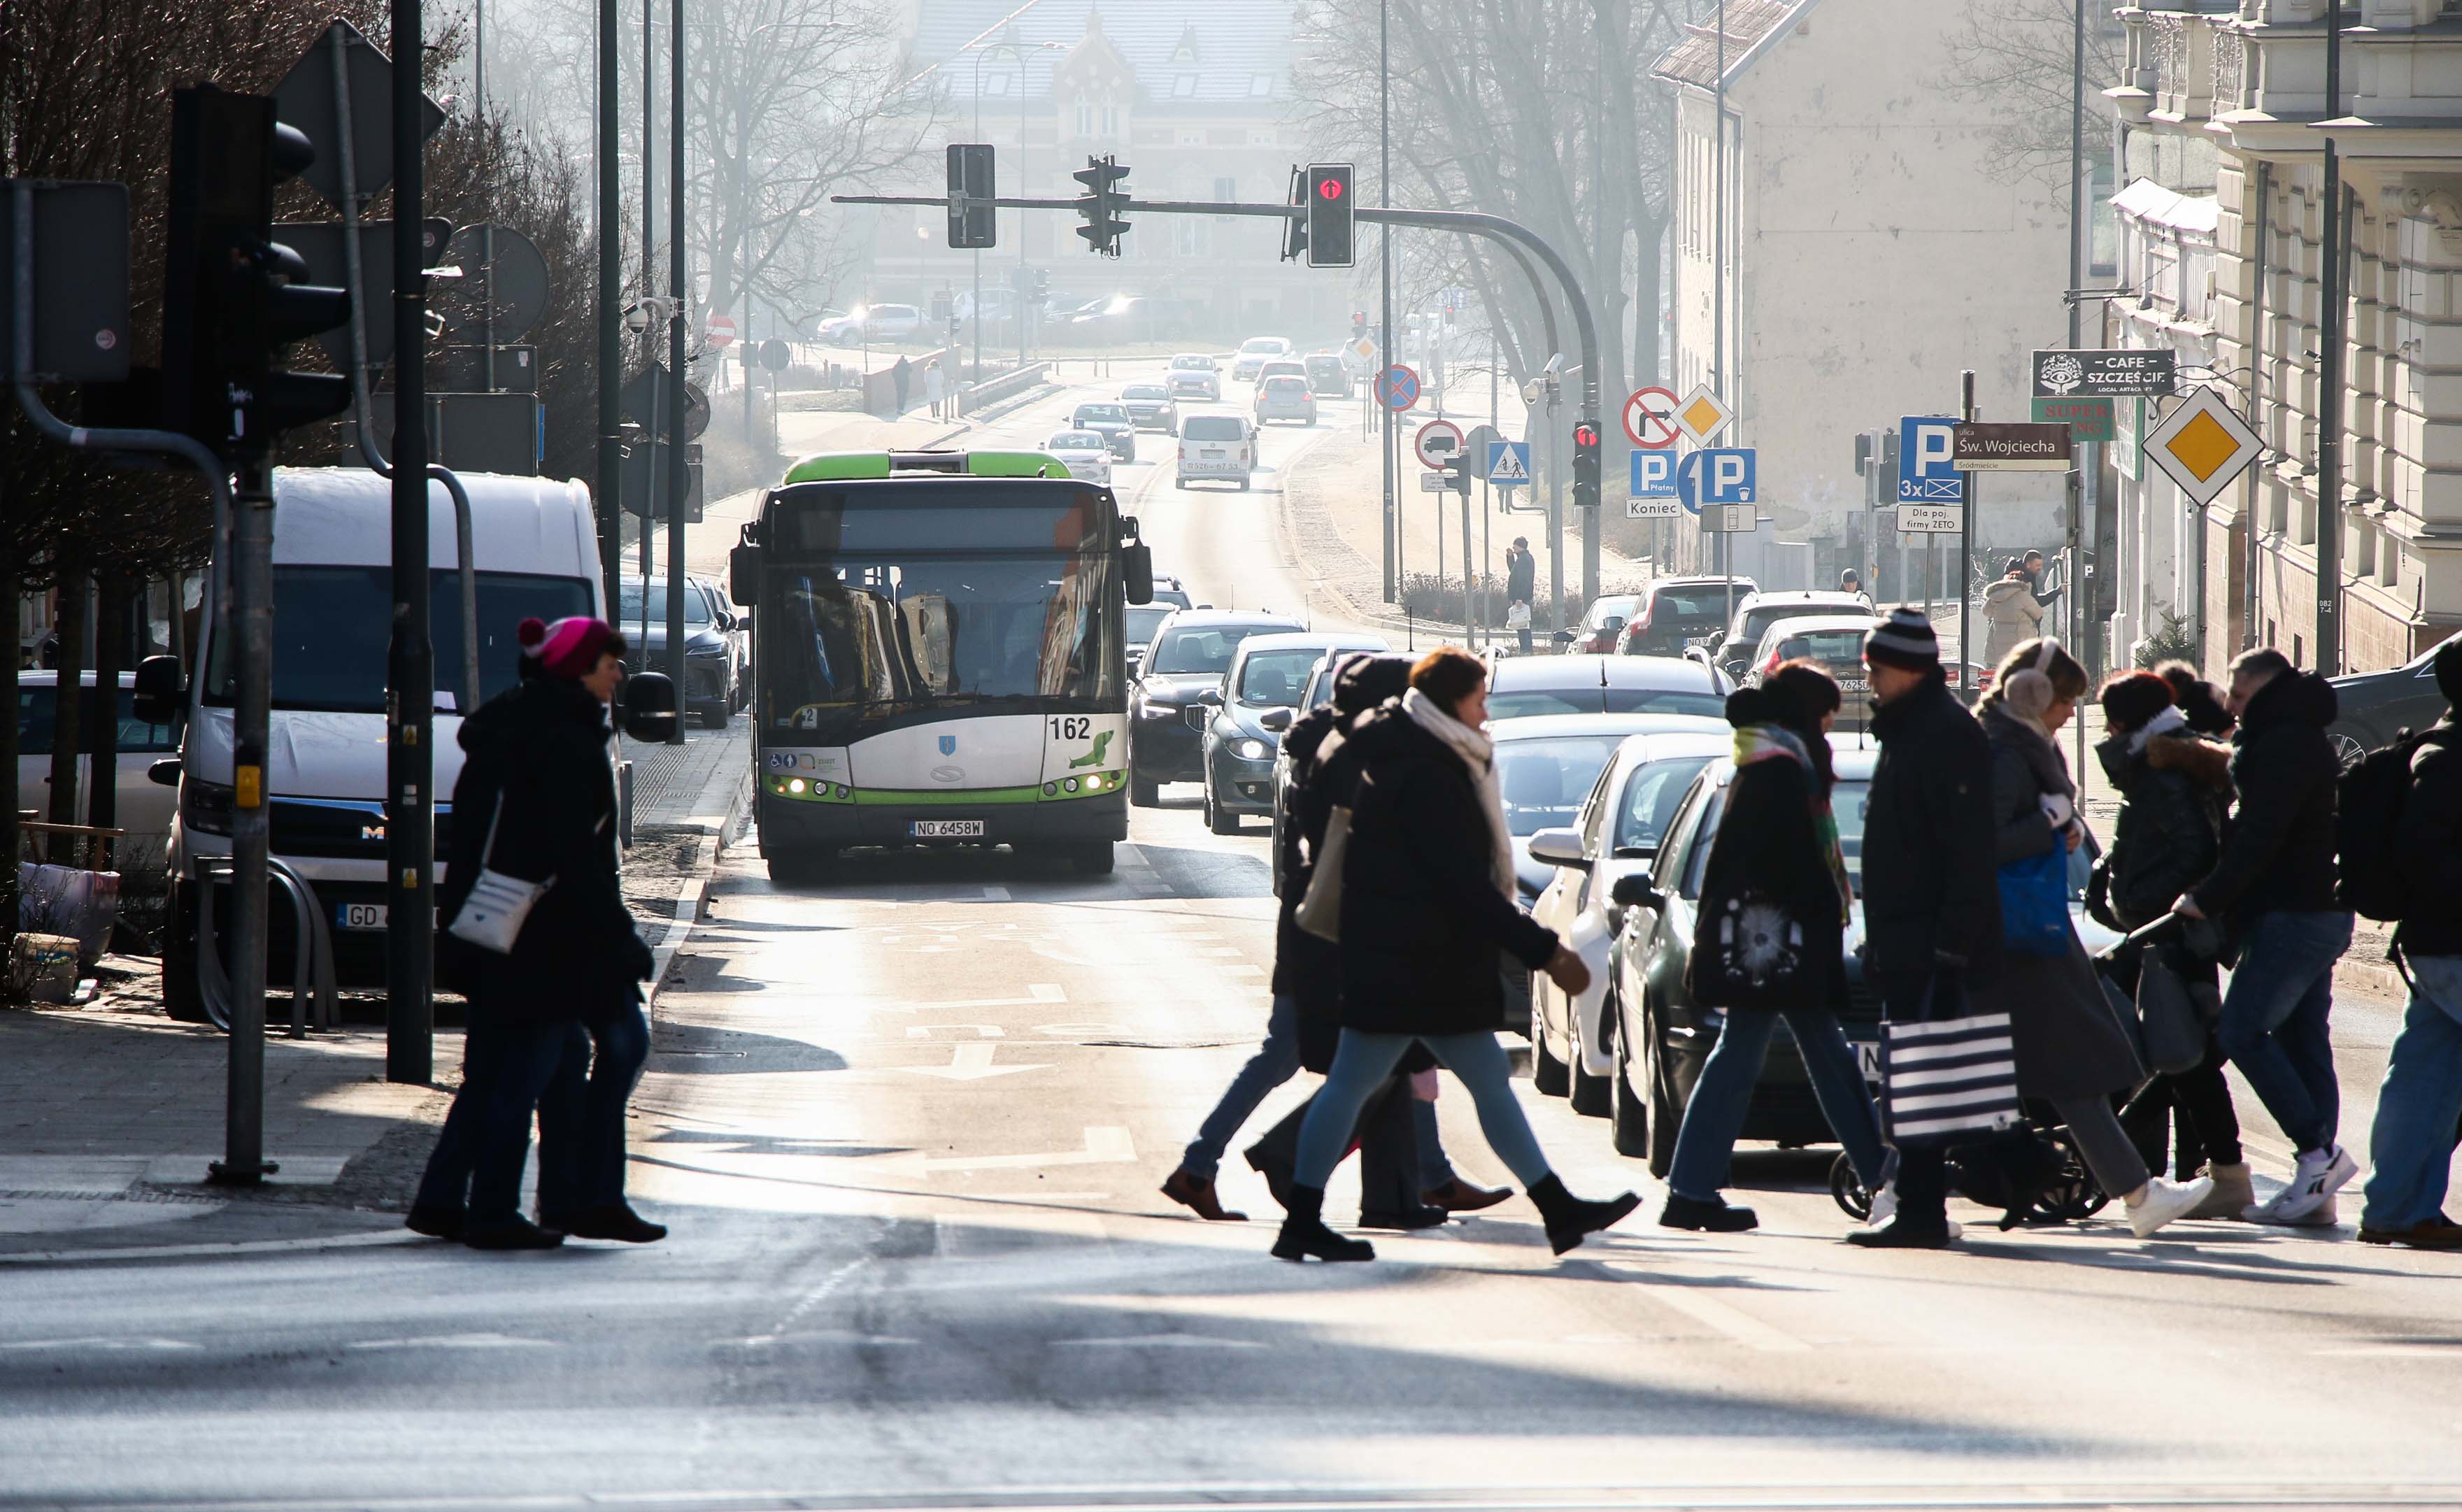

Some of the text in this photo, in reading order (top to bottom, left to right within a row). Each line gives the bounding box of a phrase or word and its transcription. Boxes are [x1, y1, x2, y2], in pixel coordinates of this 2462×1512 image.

[2106, 357, 2145, 368] CAFE
[2045, 404, 2108, 418] SUPER
[1915, 425, 1954, 477] P
[1959, 438, 2056, 455] Św. Wojciecha
[1642, 455, 1667, 491] P
[1714, 455, 1744, 497] P
[1650, 484, 1674, 492] Płatny
[1900, 480, 1923, 497] 3x
[1631, 502, 1677, 514] Koniec
[1913, 508, 1949, 520] Dla poj.
[1907, 521, 1929, 530] firmy
[2084, 565, 2093, 576] P
[1050, 717, 1090, 740] 162
[918, 822, 981, 835] NO 6458W
[350, 906, 377, 926] GD
[1865, 1046, 1881, 1072] N
